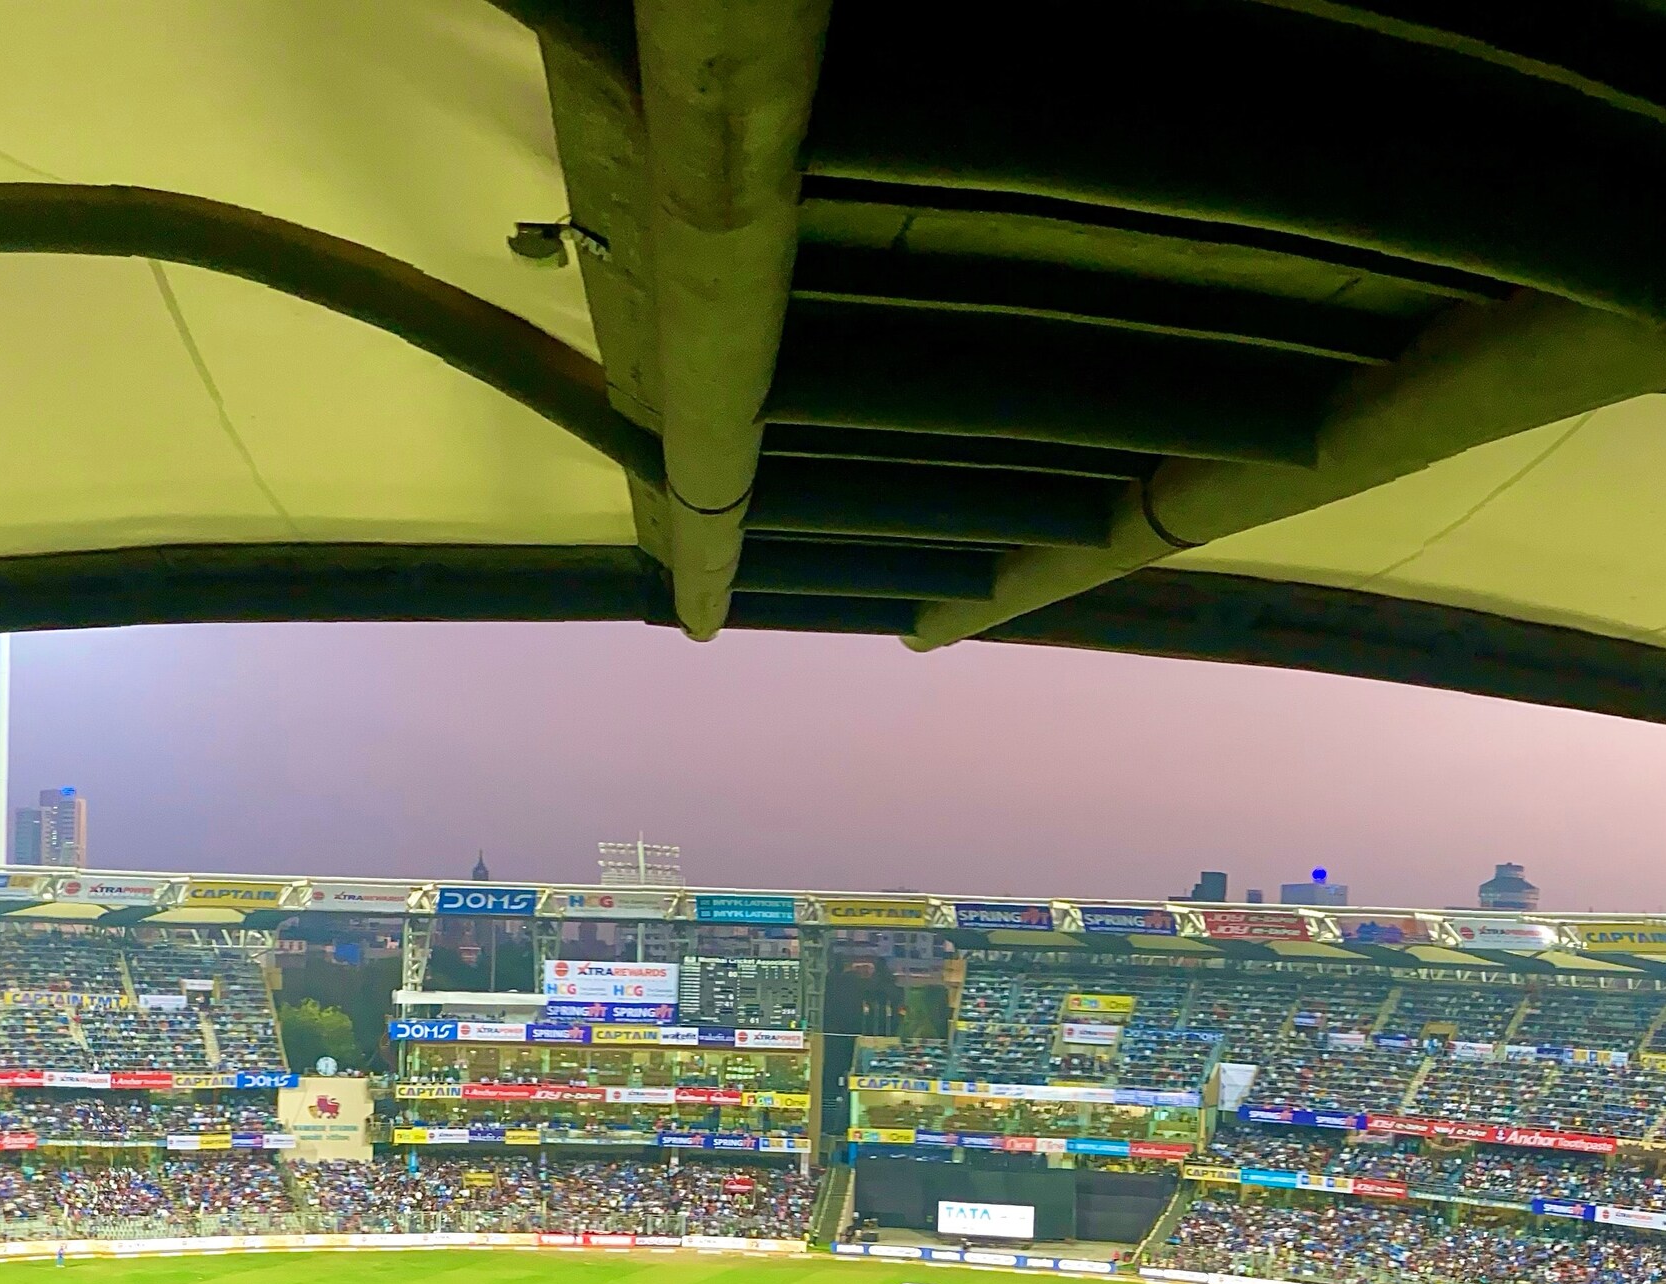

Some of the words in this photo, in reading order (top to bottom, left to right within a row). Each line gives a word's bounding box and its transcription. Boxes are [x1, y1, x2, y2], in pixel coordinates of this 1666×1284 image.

[190, 887, 278, 901] CAPTAIN
[442, 892, 533, 910] DOMS
[568, 895, 614, 909] HCG
[831, 906, 921, 919] CAPTAIN
[1209, 926, 1251, 935] JOY
[576, 961, 667, 978] XTRAREWARDS
[547, 983, 577, 996] HCG
[613, 984, 643, 997] HCG
[8, 992, 81, 1008] CAPTAIN
[87, 995, 128, 1010] TMT
[396, 1024, 455, 1038] DOMS
[595, 1030, 658, 1041] CAPTAIN
[176, 1076, 234, 1086] CAPTAIN
[245, 1075, 291, 1087] DOMS
[857, 1077, 929, 1091] CAPTAIN
[398, 1085, 461, 1097] CAPTAIN
[530, 1091, 562, 1099] JOY
[784, 1097, 807, 1107] One
[1367, 1118, 1395, 1129] JOY
[1506, 1129, 1557, 1147] Anchor
[1557, 1137, 1614, 1152] Toothpaste
[1185, 1167, 1239, 1179] CAPTAIN
[945, 1206, 991, 1220] TATA
